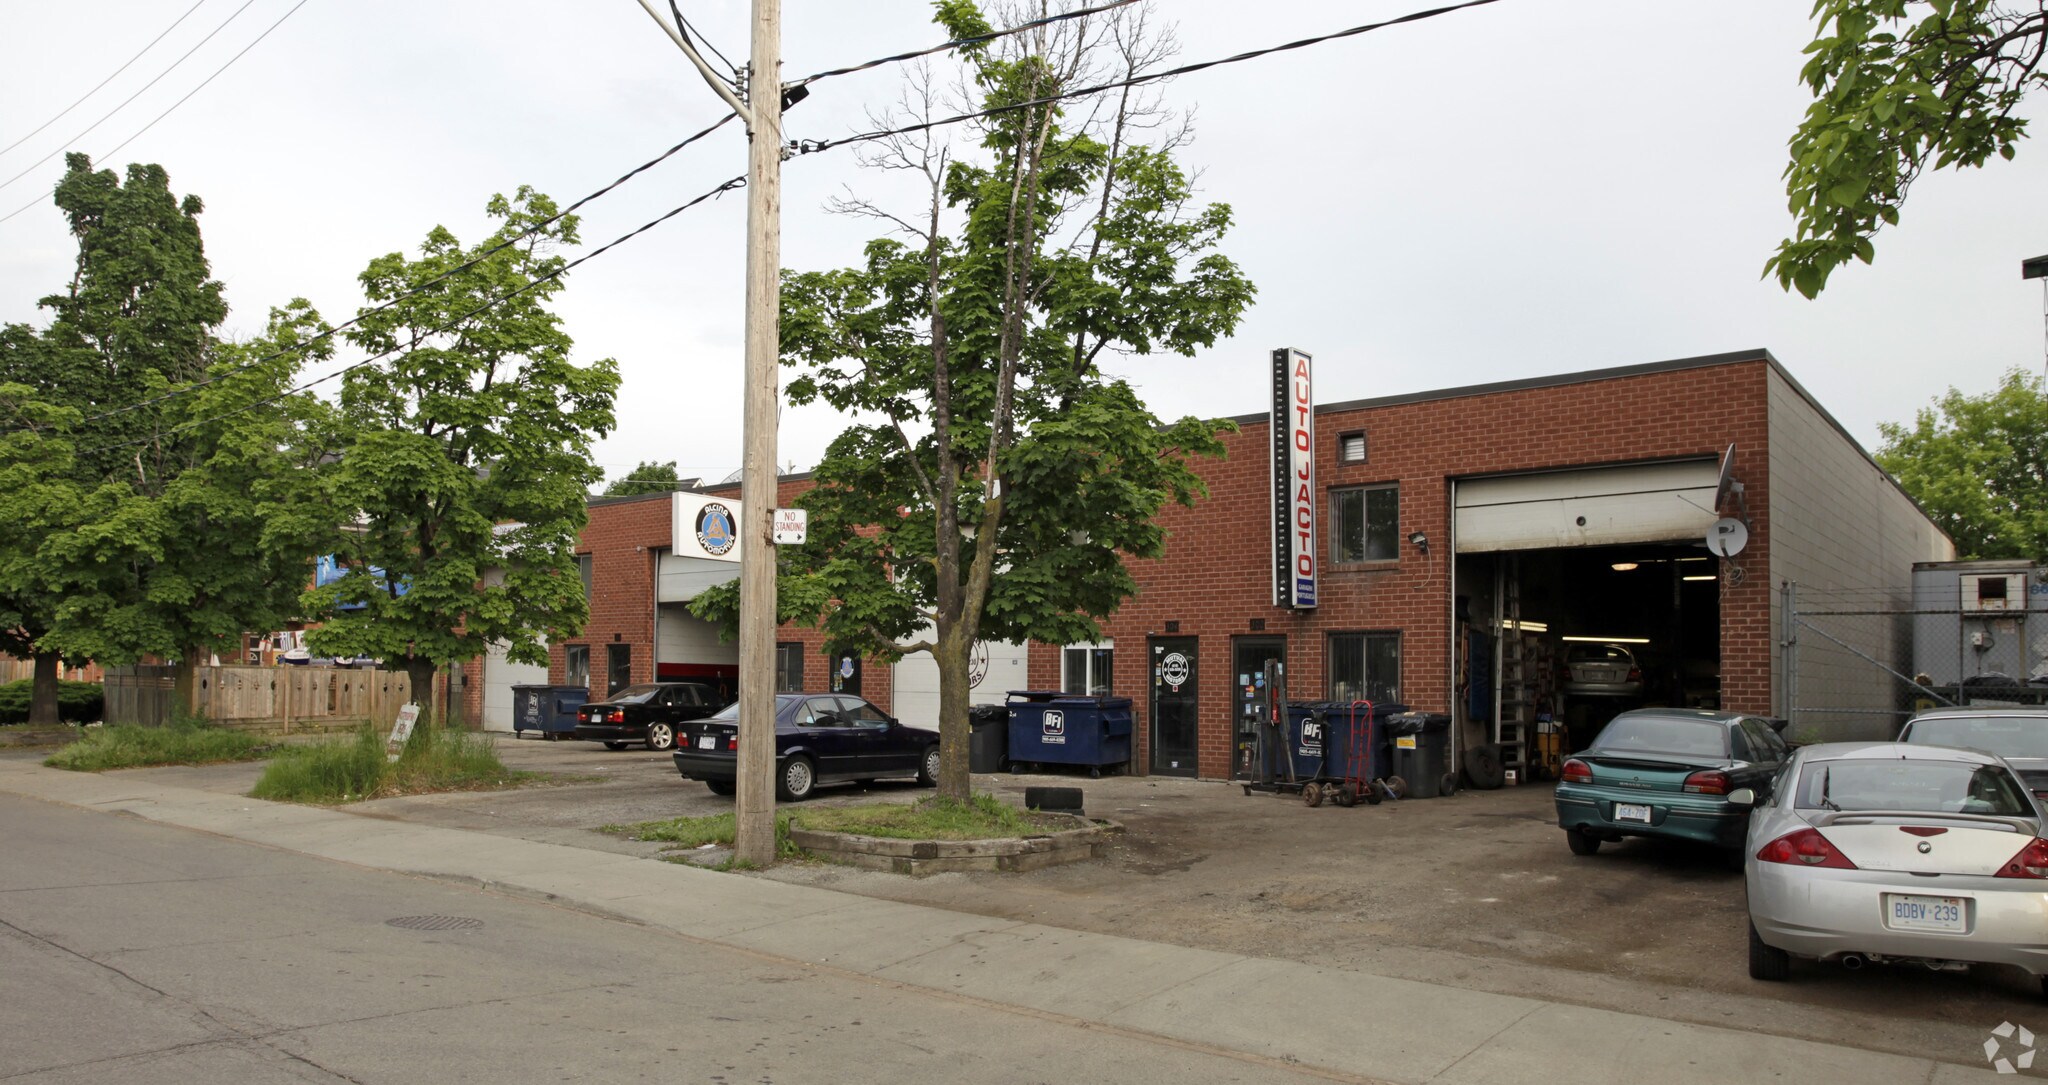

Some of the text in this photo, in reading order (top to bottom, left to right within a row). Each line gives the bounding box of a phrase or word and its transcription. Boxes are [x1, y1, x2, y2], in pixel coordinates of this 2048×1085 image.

[1295, 359, 1312, 576] AUTO JACTO
[704, 504, 728, 516] ALCINA
[784, 511, 796, 521] NO
[775, 522, 805, 532] STANDING
[697, 532, 736, 555] AUTOMOTIVE
[1165, 655, 1185, 665] MUTUAL
[1166, 674, 1185, 683] MOTORS
[1045, 712, 1061, 729] BFI
[1895, 902, 1959, 921] BDBV 239
